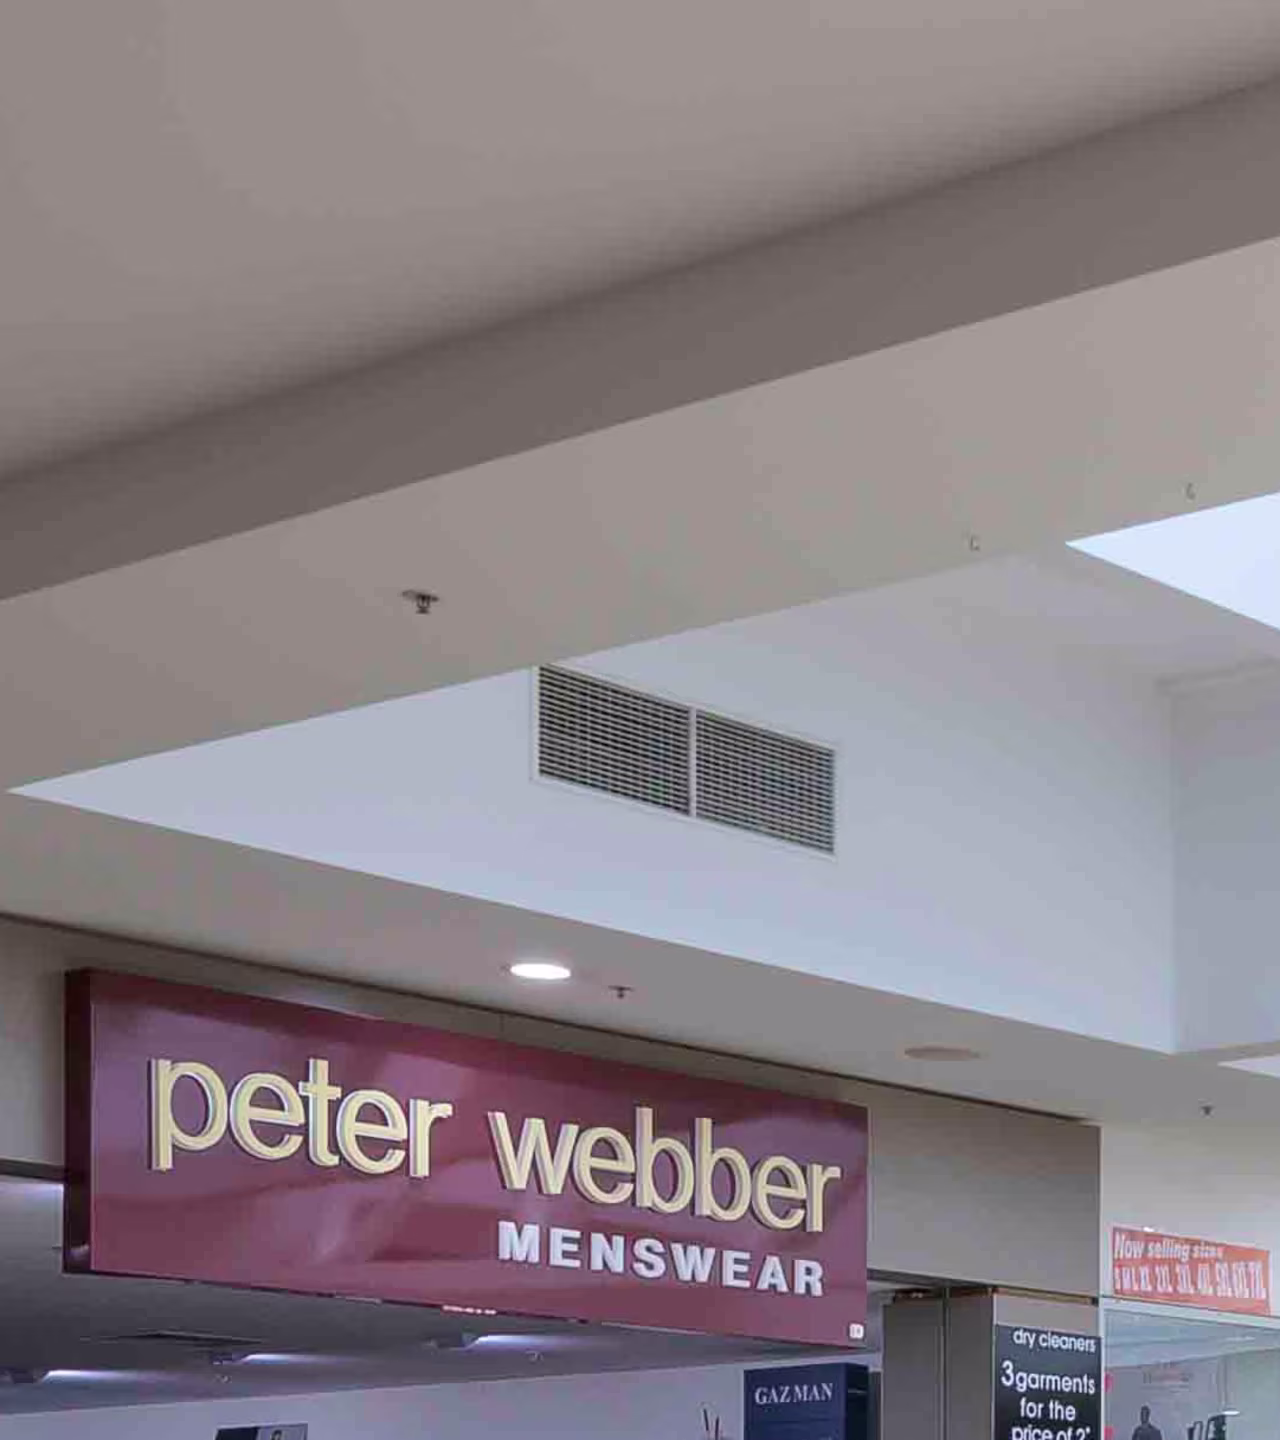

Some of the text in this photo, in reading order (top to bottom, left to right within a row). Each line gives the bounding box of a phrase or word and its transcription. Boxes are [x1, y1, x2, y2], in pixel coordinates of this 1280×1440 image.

[150, 1057, 841, 1233] peter webber
[497, 1220, 824, 1296] MENSWEAR
[1114, 1231, 1144, 1259] Now
[1147, 1237, 1190, 1262] selling
[1013, 1328, 1096, 1353] dry cleaners
[1001, 1360, 1096, 1394] 3 garments
[754, 1382, 834, 1405] GAZMAN
[1020, 1396, 1076, 1421] for the
